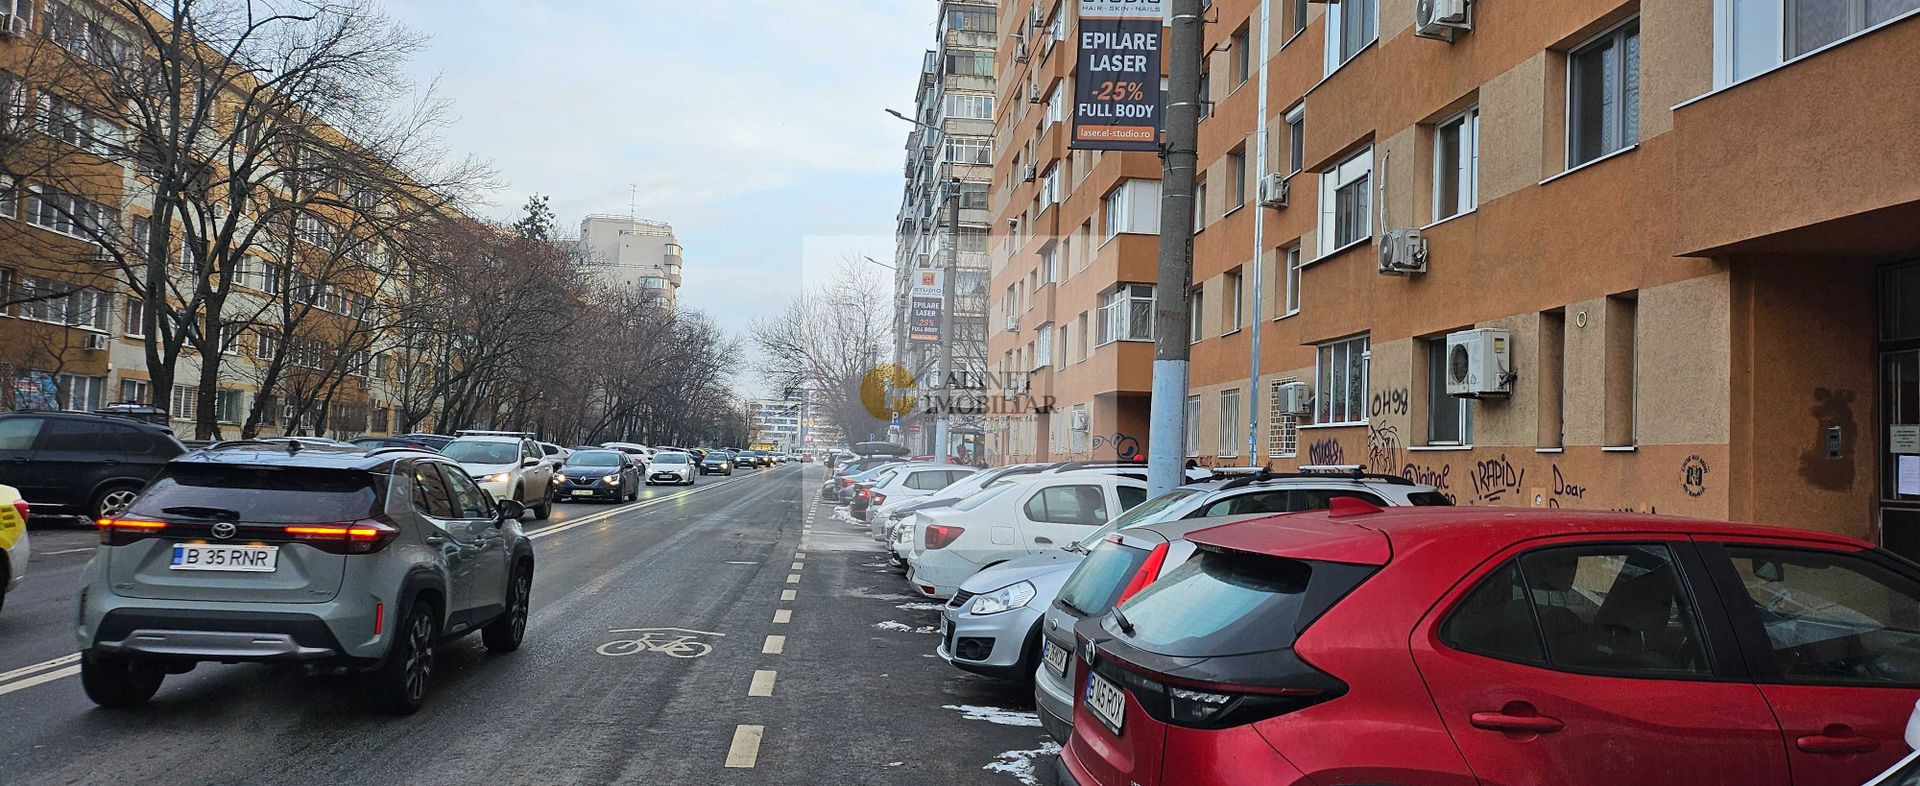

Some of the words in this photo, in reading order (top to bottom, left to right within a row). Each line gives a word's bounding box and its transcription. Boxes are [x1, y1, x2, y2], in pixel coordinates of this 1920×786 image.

[1082, 32, 1158, 51] EPILARE
[1089, 54, 1147, 72] LASER
[1091, 81, 1144, 101] -25%
[1078, 103, 1112, 117] FULL
[1115, 104, 1154, 118] BODY
[1080, 128, 1151, 138] laser.el-studio.ro
[913, 301, 940, 310] EPILARE
[915, 309, 936, 317] LASER
[1552, 464, 1586, 499] Doar
[186, 549, 200, 564] B
[205, 549, 226, 565] 35
[229, 550, 268, 566] RNR
[1089, 675, 1096, 699] B
